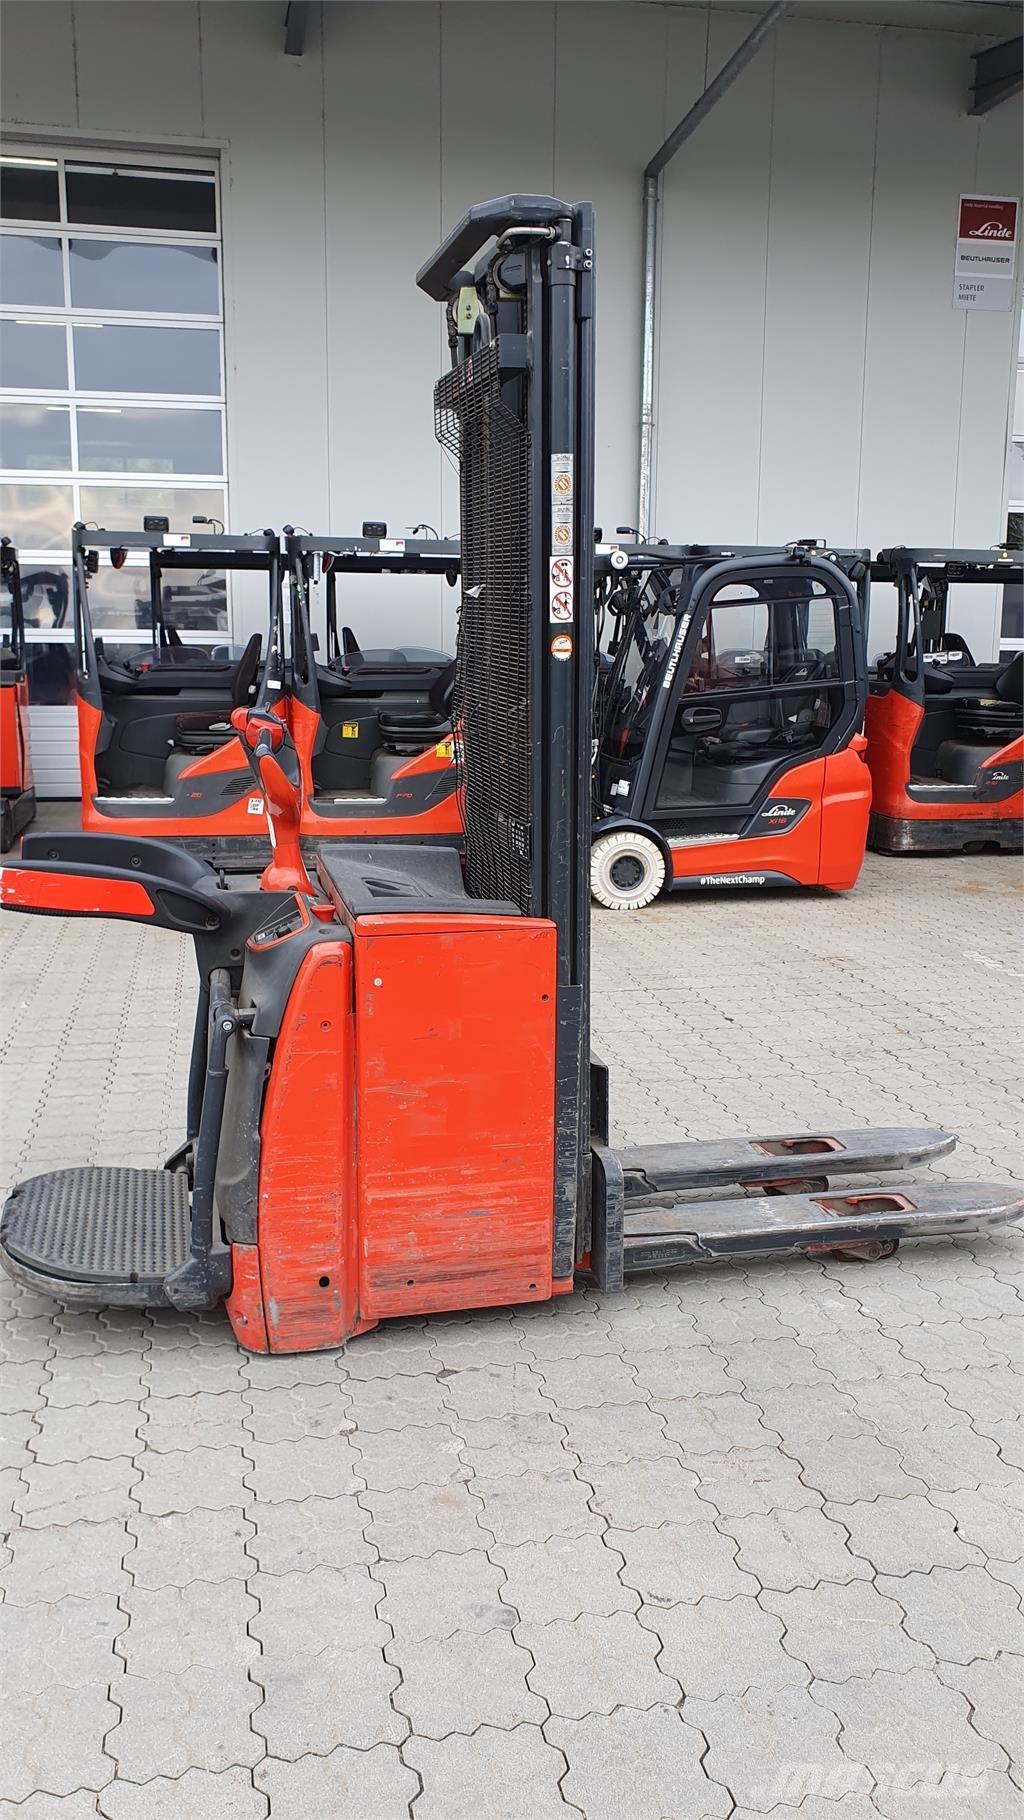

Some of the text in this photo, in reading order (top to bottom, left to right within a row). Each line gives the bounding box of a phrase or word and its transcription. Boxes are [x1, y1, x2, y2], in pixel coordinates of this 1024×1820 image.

[969, 221, 1012, 238] Linde
[960, 255, 1010, 263] BEUTLHAUSER
[959, 284, 985, 292] STAPLER
[958, 294, 976, 302] MIETE
[662, 613, 692, 689] BEUTLHAUSER
[761, 804, 796, 817] Linde
[700, 875, 765, 885] #TheNextChamp
